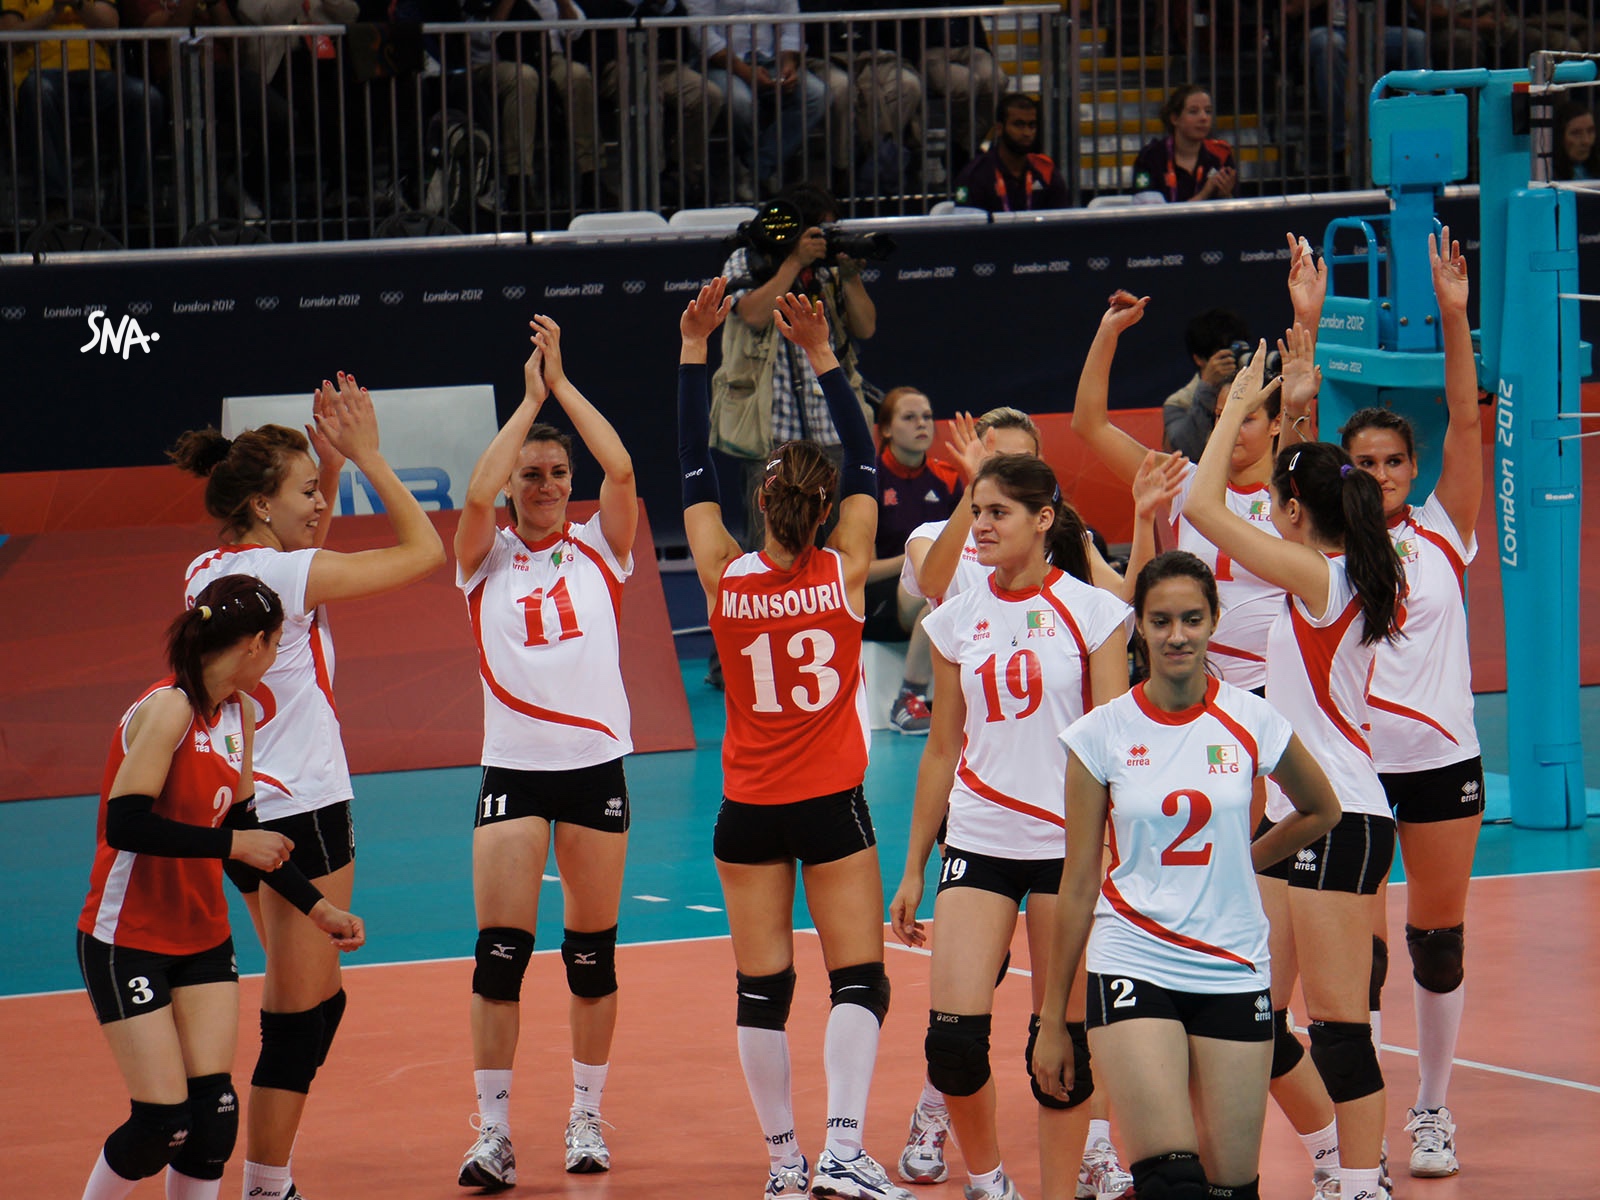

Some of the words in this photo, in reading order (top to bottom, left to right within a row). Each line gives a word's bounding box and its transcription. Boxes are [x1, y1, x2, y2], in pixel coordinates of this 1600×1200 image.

[1012, 262, 1047, 274] London
[1048, 260, 1070, 272] 2012
[1127, 256, 1160, 268] London
[1161, 254, 1184, 266] 2012
[898, 268, 932, 280] London
[933, 266, 956, 278] 2012
[544, 285, 580, 297] London
[582, 284, 604, 296] 2012
[664, 280, 699, 292] London
[299, 296, 336, 308] London
[338, 294, 361, 306] 2012
[422, 291, 459, 302] London
[460, 289, 483, 301] 2012
[44, 305, 82, 318] London
[172, 301, 210, 313] London
[212, 299, 236, 312] 2012
[1319, 313, 1345, 329] ondon
[1346, 315, 1365, 331] 2012
[1498, 378, 1513, 447] 2012
[1502, 459, 1517, 567] London
[722, 581, 842, 620] MANSOURI
[516, 576, 584, 647] 11
[1027, 628, 1056, 639] ALG
[740, 628, 841, 713] 13
[974, 649, 1044, 723] 19
[228, 753, 242, 763] AL
[1126, 757, 1151, 767] errea
[1208, 762, 1240, 775] ALG
[1461, 792, 1479, 803] errea
[482, 793, 508, 818] 11
[604, 807, 622, 817] errea
[1160, 788, 1213, 867] 2
[941, 856, 968, 884] 19
[1294, 860, 1317, 872] errea
[127, 976, 155, 1005] 3
[1110, 978, 1138, 1009] 2
